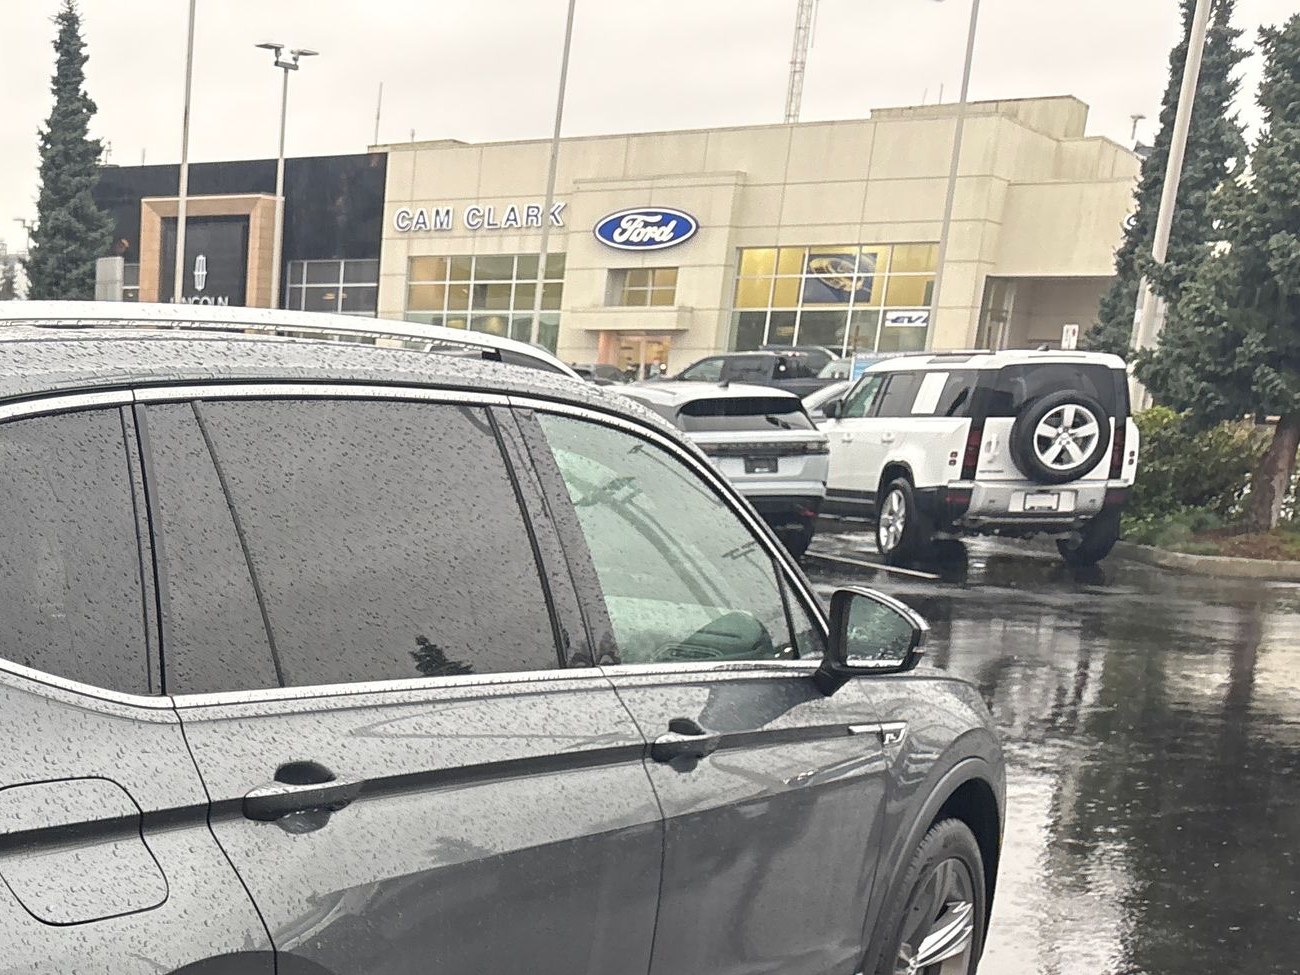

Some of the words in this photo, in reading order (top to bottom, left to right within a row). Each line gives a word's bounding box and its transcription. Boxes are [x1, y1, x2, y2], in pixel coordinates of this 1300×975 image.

[394, 207, 452, 232] CAM
[464, 202, 566, 229] CLARK
[613, 214, 677, 242] Ford
[170, 295, 229, 306] LNCOLN
